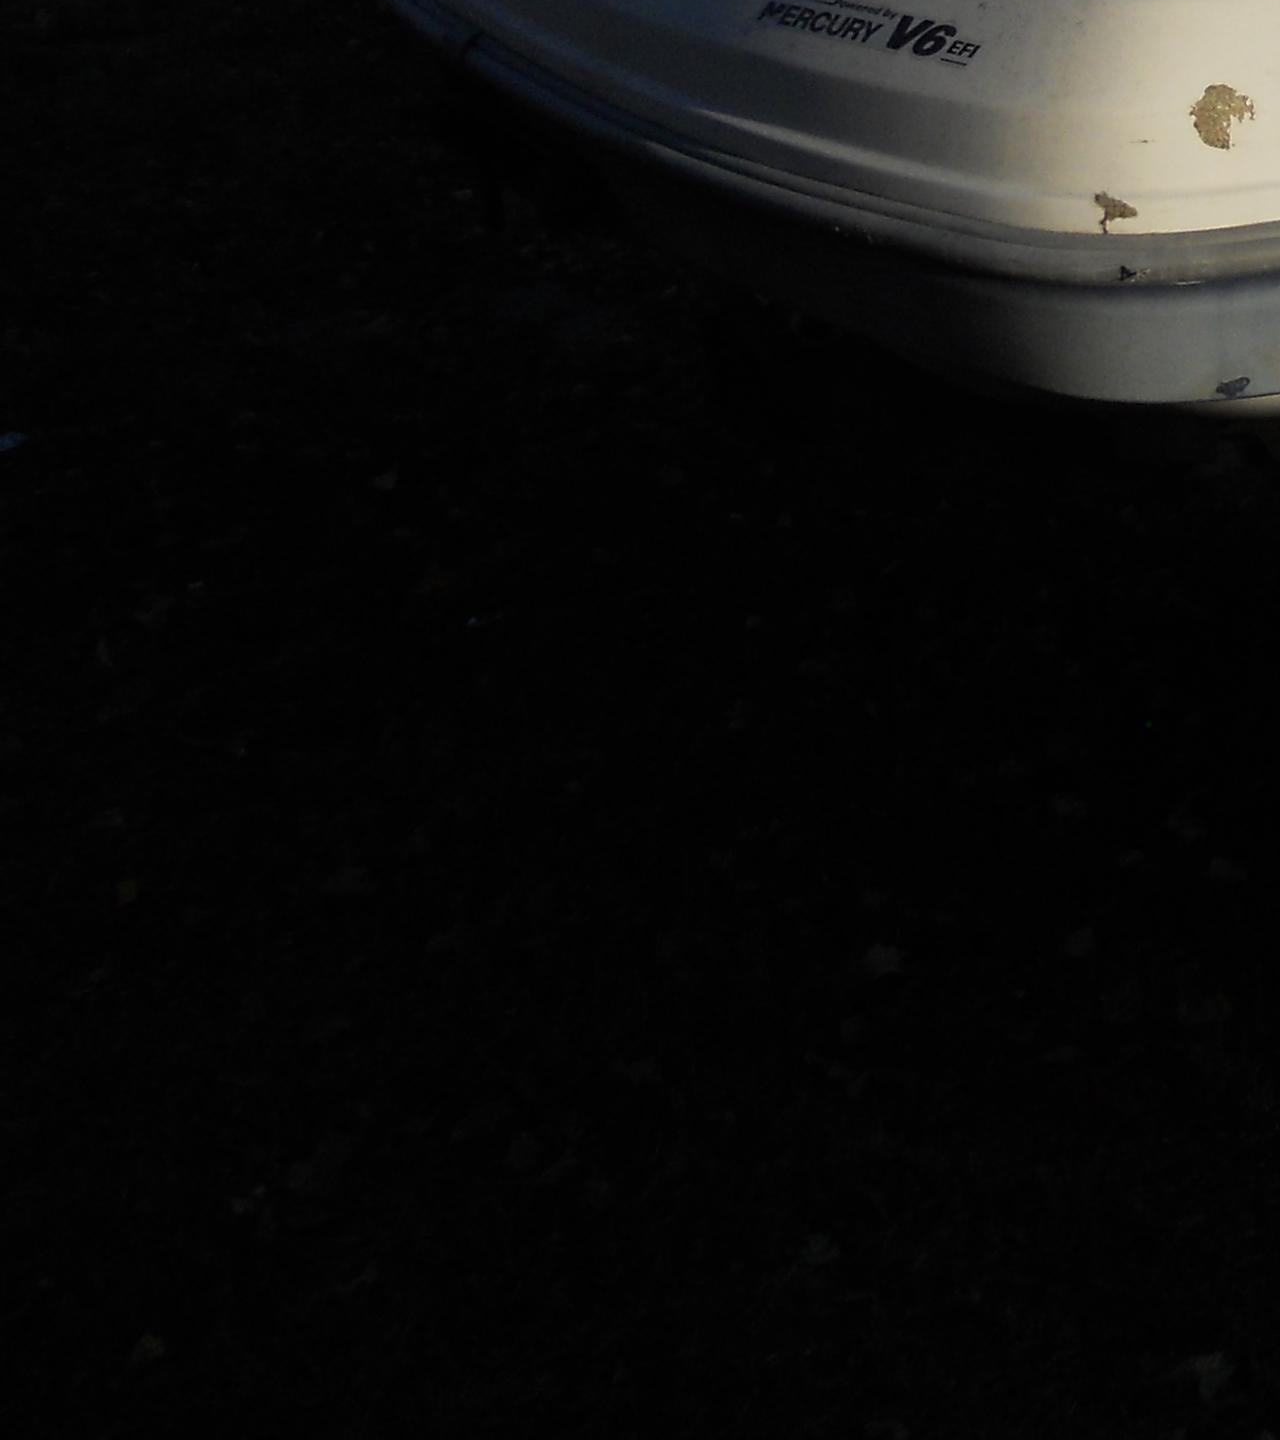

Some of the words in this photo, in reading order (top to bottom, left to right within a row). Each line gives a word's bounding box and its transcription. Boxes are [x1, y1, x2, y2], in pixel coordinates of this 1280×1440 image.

[758, 1, 884, 42] MERCURY
[886, 14, 957, 57] V6
[946, 40, 980, 58] EFI
